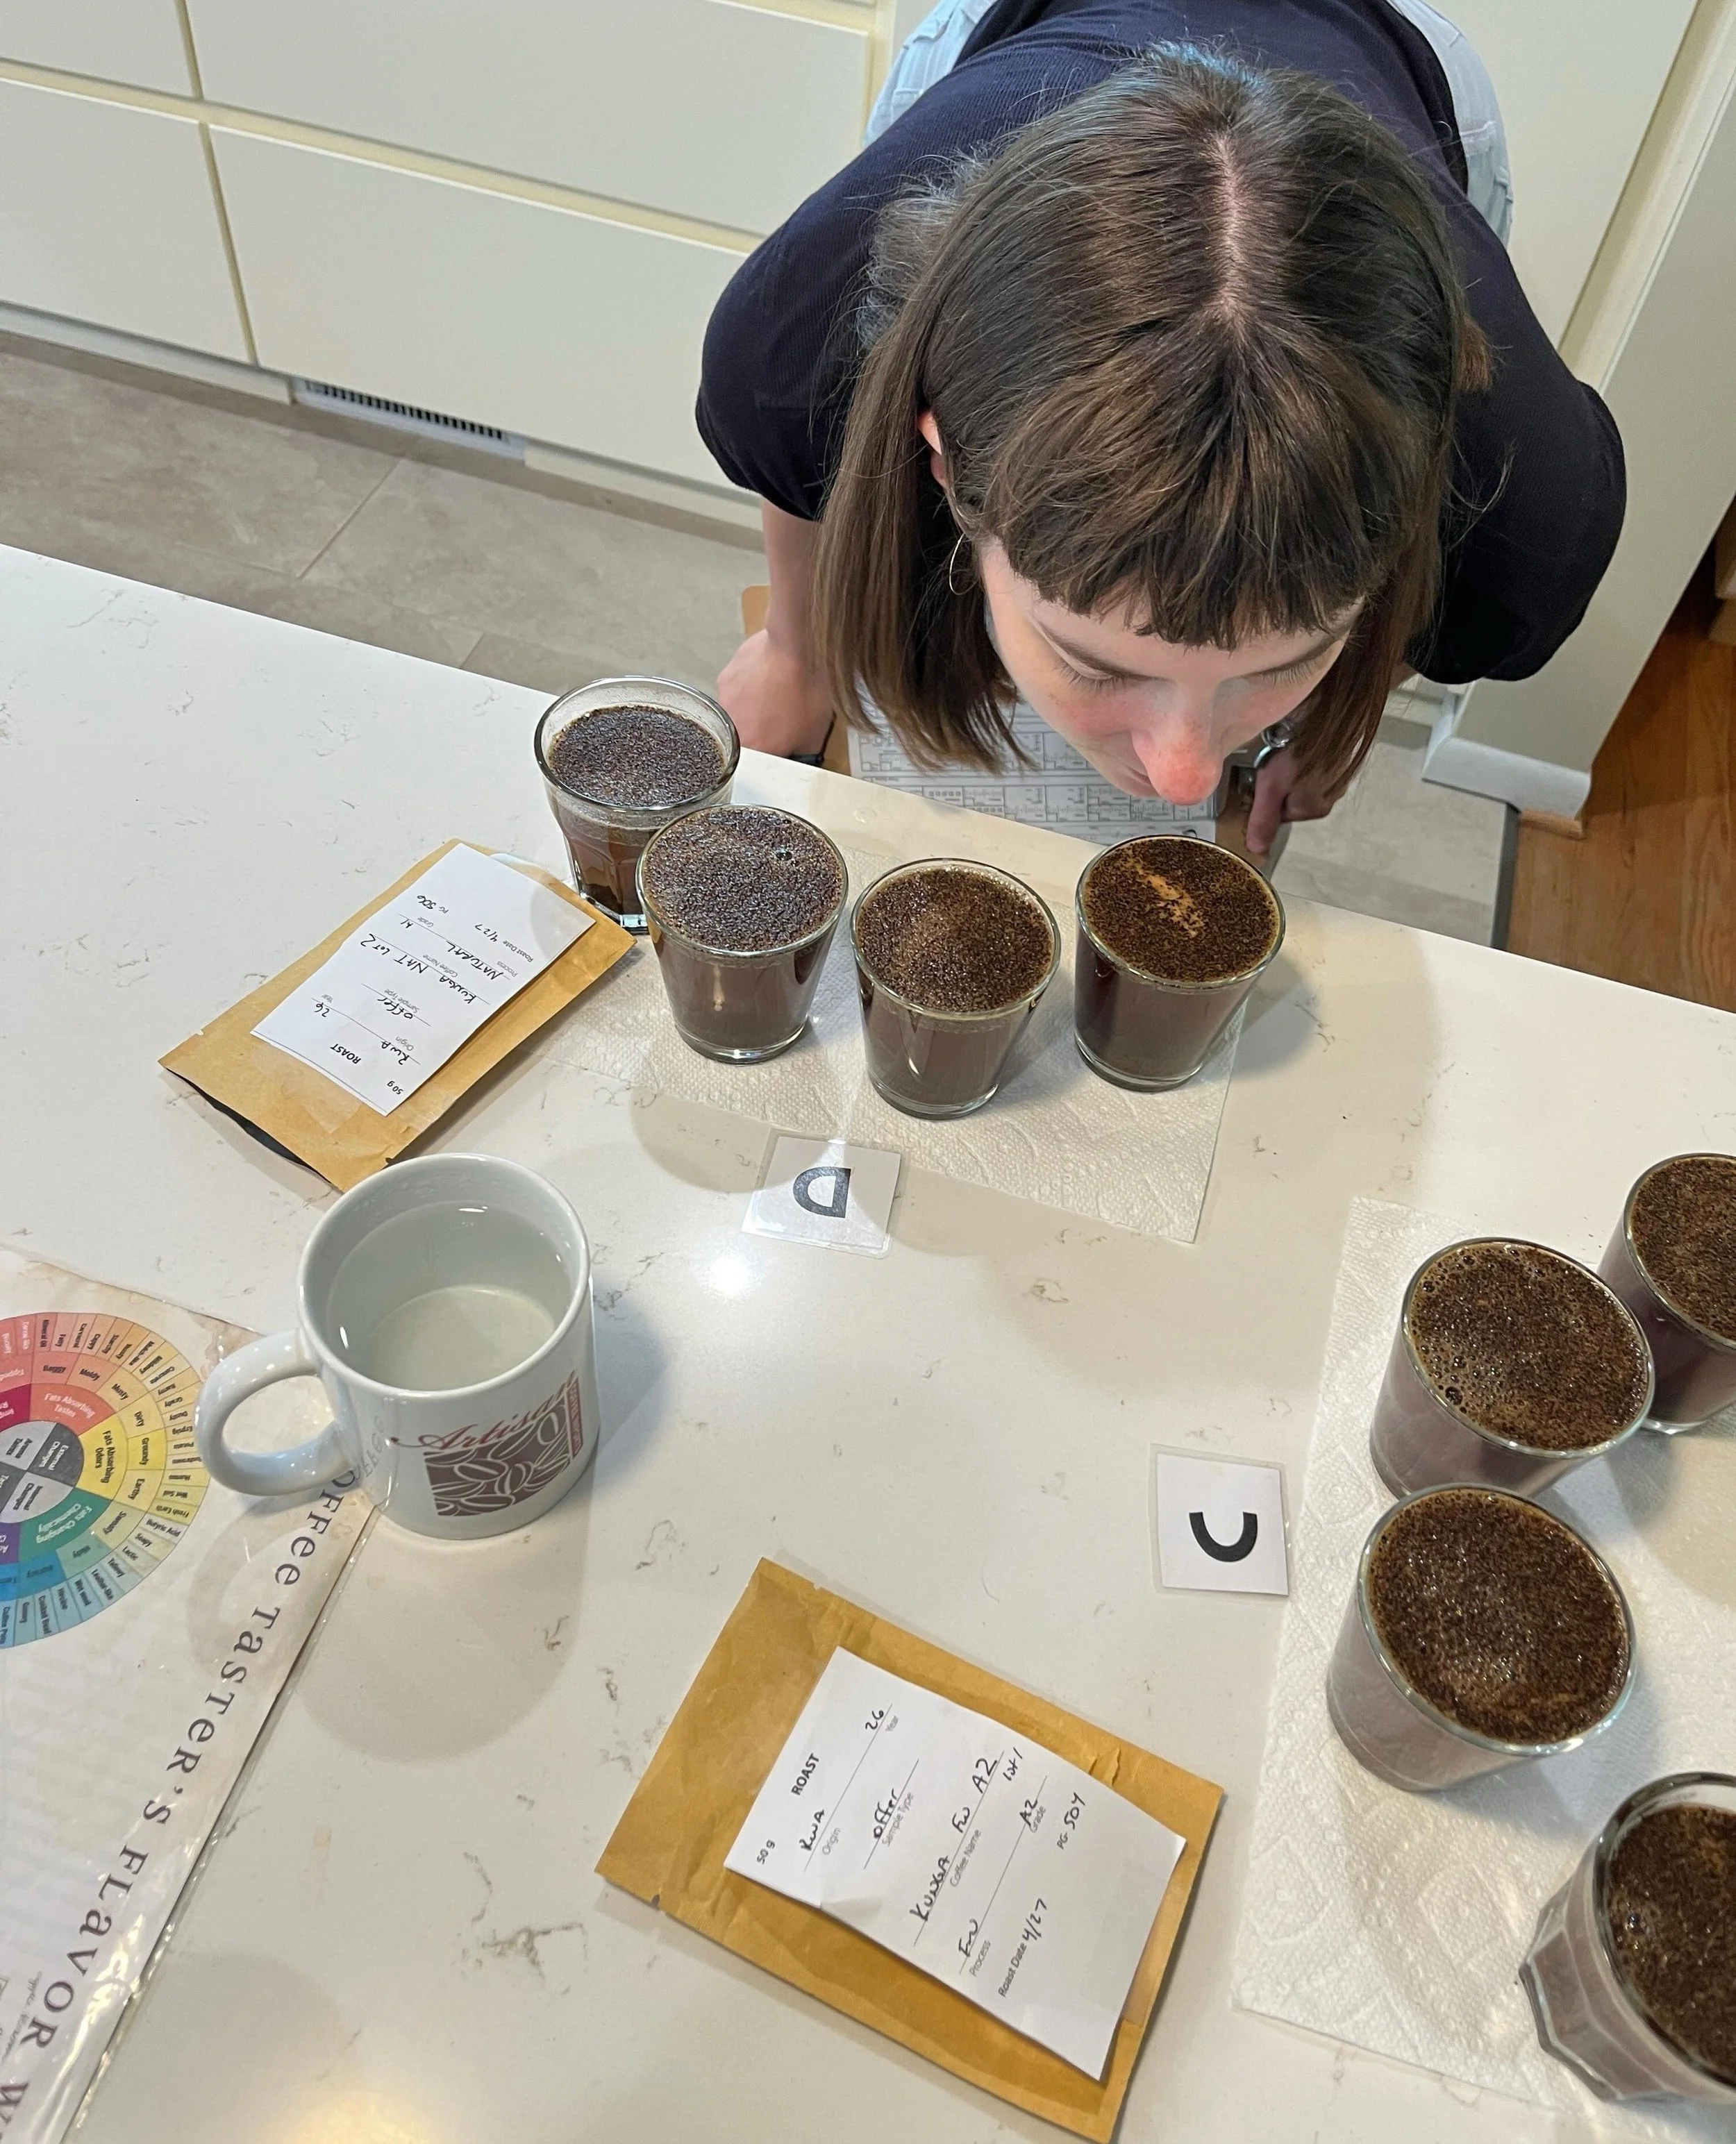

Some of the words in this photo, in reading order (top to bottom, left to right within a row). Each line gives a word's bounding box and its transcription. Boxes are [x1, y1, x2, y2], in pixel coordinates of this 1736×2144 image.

[360, 933, 376, 947] 2
[475, 923, 498, 943] 4/27
[503, 939, 517, 953] Date
[516, 949, 534, 963] Roast
[393, 954, 429, 974] NAT
[423, 954, 440, 966] Name
[446, 940, 504, 980] NATURAL
[496, 960, 518, 978] Process
[440, 964, 458, 978] Coffee
[321, 994, 333, 1003] Year
[384, 989, 401, 1003] Type
[397, 997, 420, 1014] Sample
[396, 1036, 414, 1051] Origin
[330, 1044, 361, 1064] ROAST
[392, 1085, 403, 1095] 50
[793, 1166, 851, 1218] D
[44, 1393, 61, 1402] Fats
[61, 1396, 96, 1418] Absorbing
[134, 1411, 145, 1427] Dirty
[102, 1430, 112, 1446] Fats
[95, 1447, 105, 1468] Odors
[139, 1437, 149, 1466] Groundy
[100, 1447, 115, 1484] Absorbing
[128, 1479, 145, 1500] Earthy
[1189, 1511, 1258, 1562] C
[865, 1709, 884, 1730] 26
[885, 1715, 899, 1732] Year
[791, 1752, 819, 1795] ROAST
[971, 1758, 998, 1794] A2
[882, 1811, 904, 1847] Sample
[897, 1792, 914, 1814] Type
[1028, 1805, 1046, 1833] Grade
[821, 1827, 841, 1855] Origin
[1056, 1832, 1069, 1850] PG
[757, 1848, 769, 1864] 50
[949, 1855, 968, 1887] Coffee
[963, 1829, 981, 1857] Name
[969, 1939, 991, 1977] Process
[998, 1967, 1016, 1998] Roast
[1010, 1942, 1027, 1968] Date
[1022, 1898, 1047, 1941] 4/27
